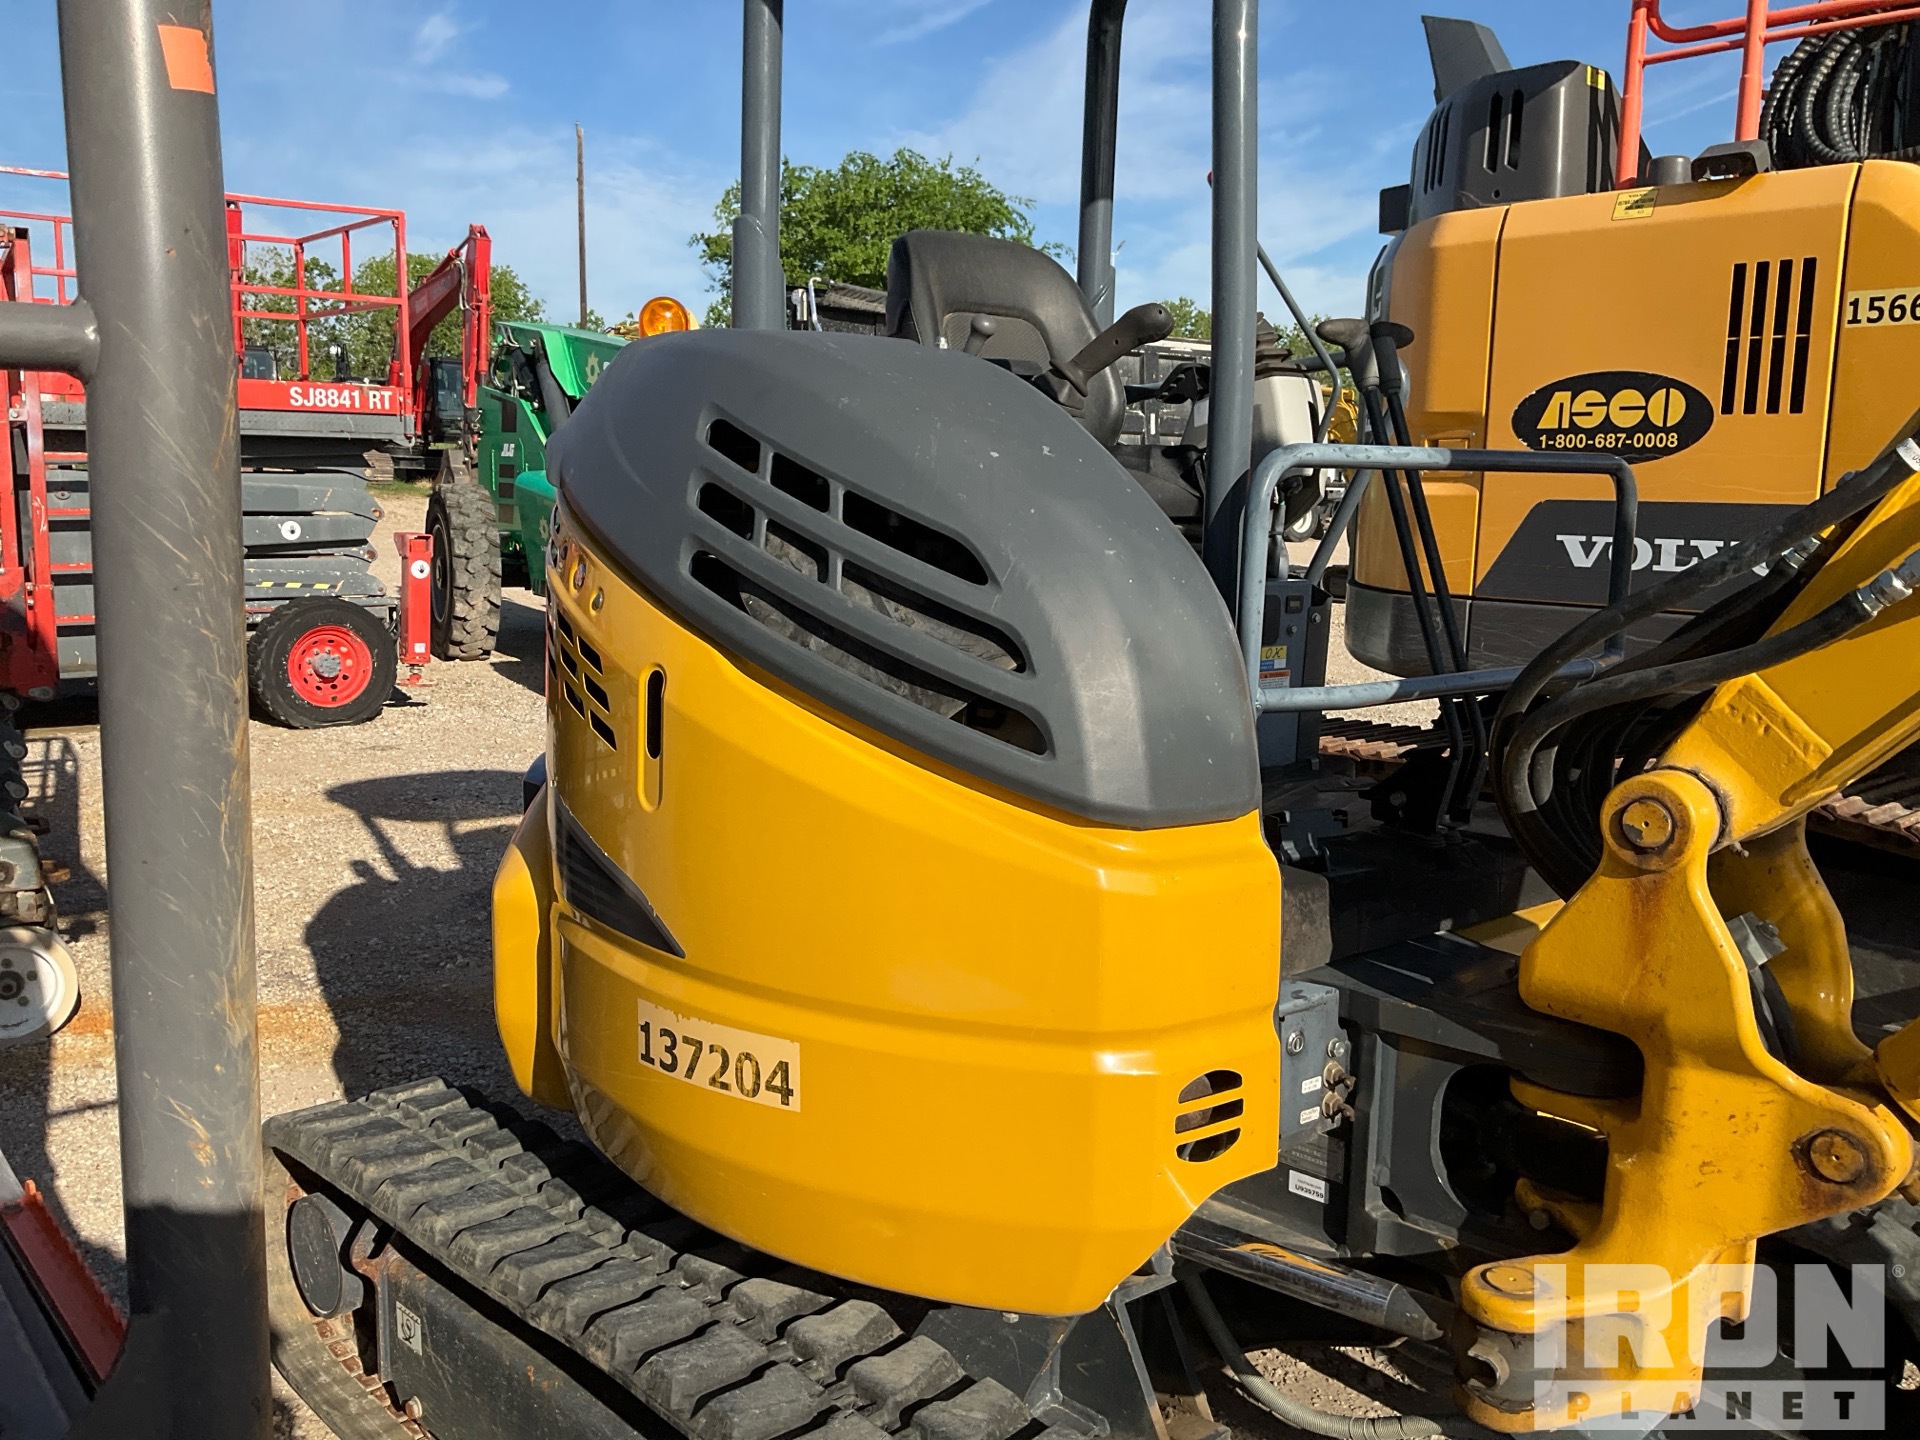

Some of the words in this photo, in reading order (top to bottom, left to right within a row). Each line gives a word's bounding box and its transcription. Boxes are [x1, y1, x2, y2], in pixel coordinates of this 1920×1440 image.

[289, 386, 360, 409] SJ8841
[368, 390, 393, 410] RT
[1536, 388, 1687, 429] ASCO
[1539, 432, 1679, 449] 1-800-687-0008
[1555, 534, 1770, 577] VOL
[640, 1021, 794, 1106] 137204
